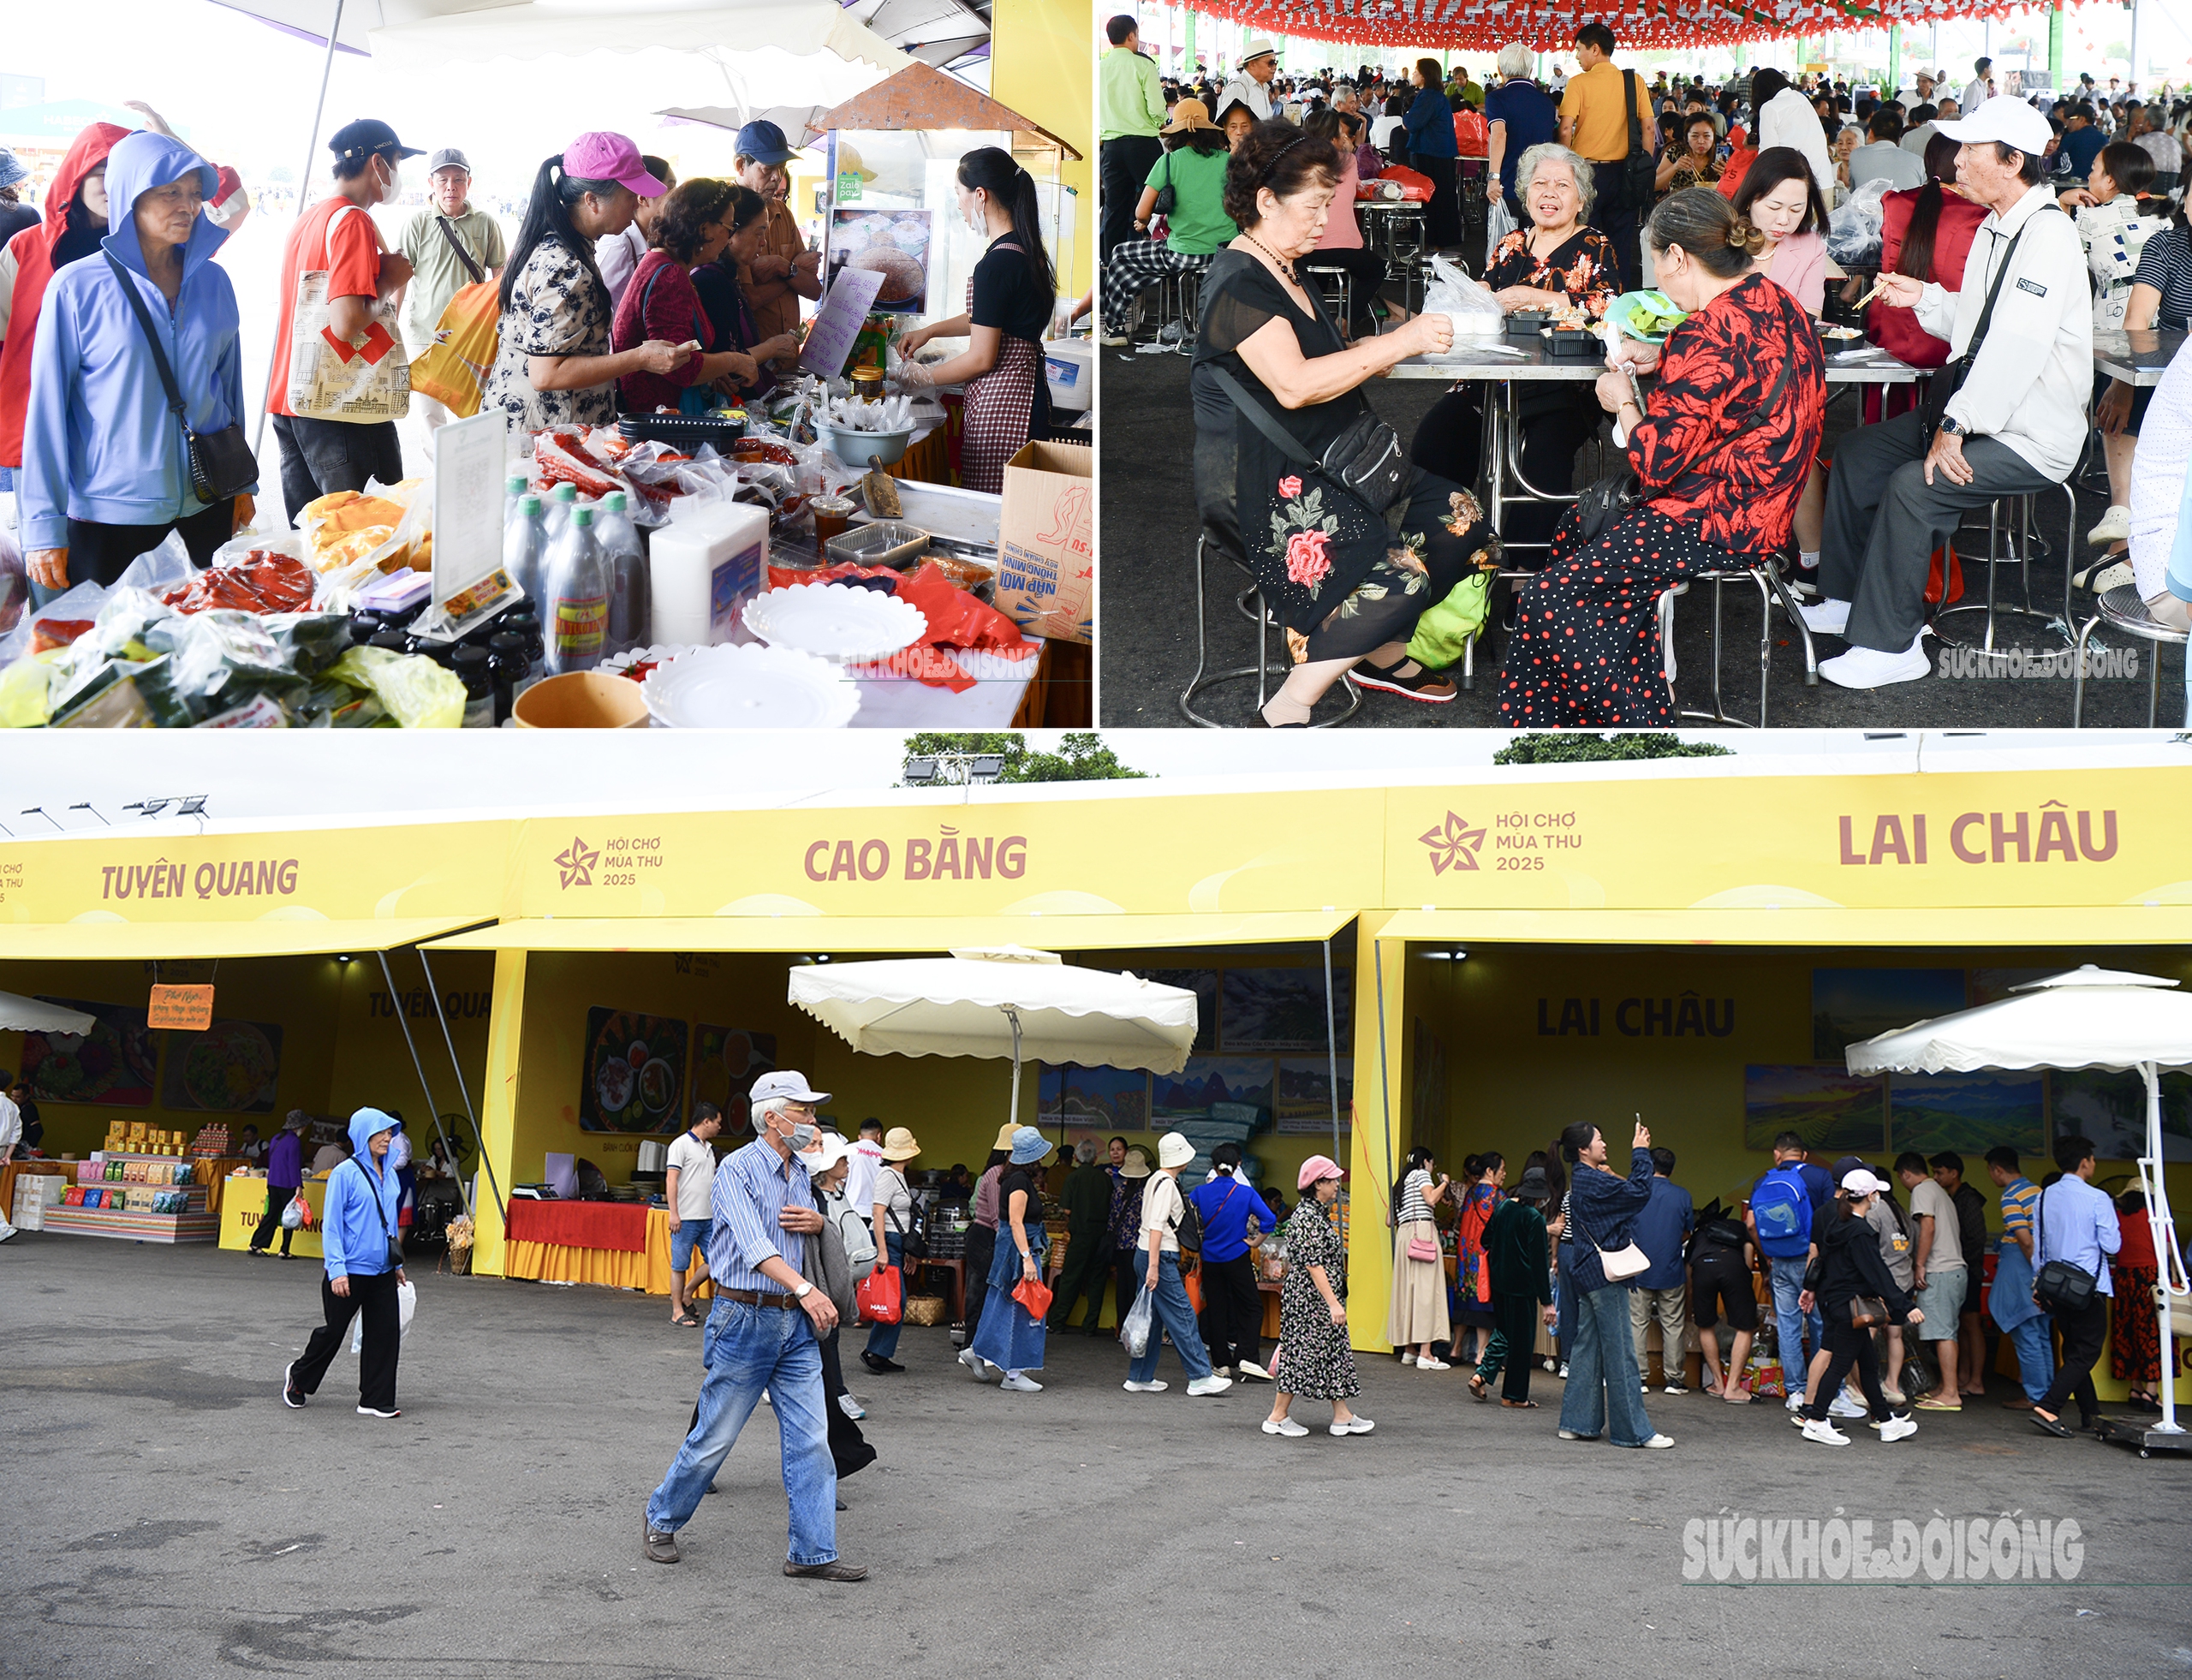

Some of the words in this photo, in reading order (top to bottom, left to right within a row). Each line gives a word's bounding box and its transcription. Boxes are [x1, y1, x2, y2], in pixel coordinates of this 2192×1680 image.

[840, 181, 860, 189] Zalo
[1003, 555, 1027, 573] MINH
[1496, 811, 1528, 831] HỘI
[1534, 811, 1576, 831] CHỢ
[1496, 831, 1538, 849] MÙA
[1544, 834, 1581, 849] THU
[1838, 814, 1927, 865] LAI
[1950, 799, 2118, 865] CHÂU
[606, 836, 630, 851] HỘI
[633, 836, 660, 851] CHỢ
[804, 839, 890, 882] CAO
[904, 823, 1028, 881] BẰNG
[605, 852, 632, 868] MÙA
[637, 855, 663, 867] THU
[1496, 856, 1545, 871] 2025
[6, 879, 23, 889] THU
[102, 857, 186, 899] TUYÊN
[194, 859, 299, 899] QUANG
[603, 873, 636, 886] 2025
[445, 992, 491, 1020] QUA
[1537, 998, 1599, 1037] LAI
[1616, 990, 1736, 1038] CHÂU
[241, 1212, 264, 1227] TUY
